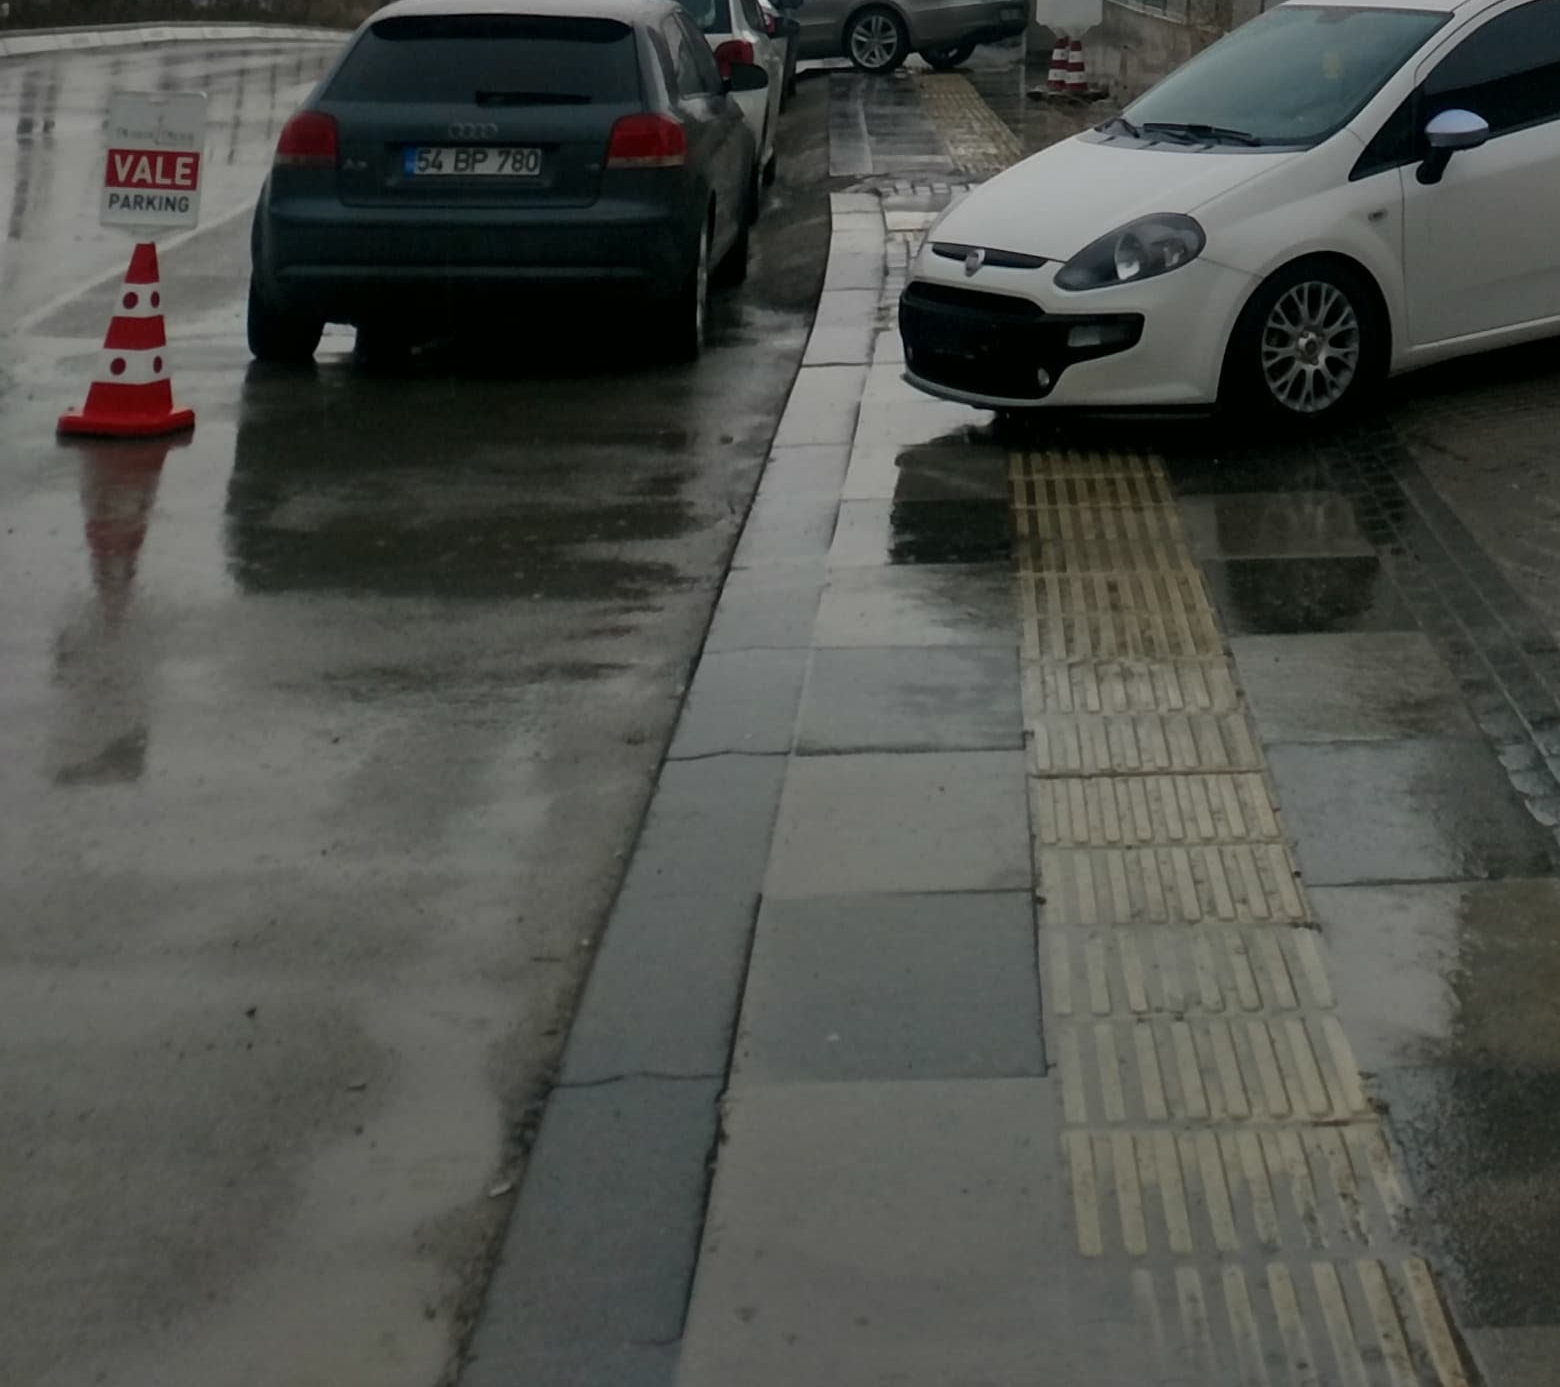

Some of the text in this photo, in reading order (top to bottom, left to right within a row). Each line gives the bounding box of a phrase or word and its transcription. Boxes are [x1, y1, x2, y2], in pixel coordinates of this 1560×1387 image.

[114, 154, 194, 186] VALE
[416, 148, 540, 173] 54 BP 780
[107, 193, 190, 213] PARKING
